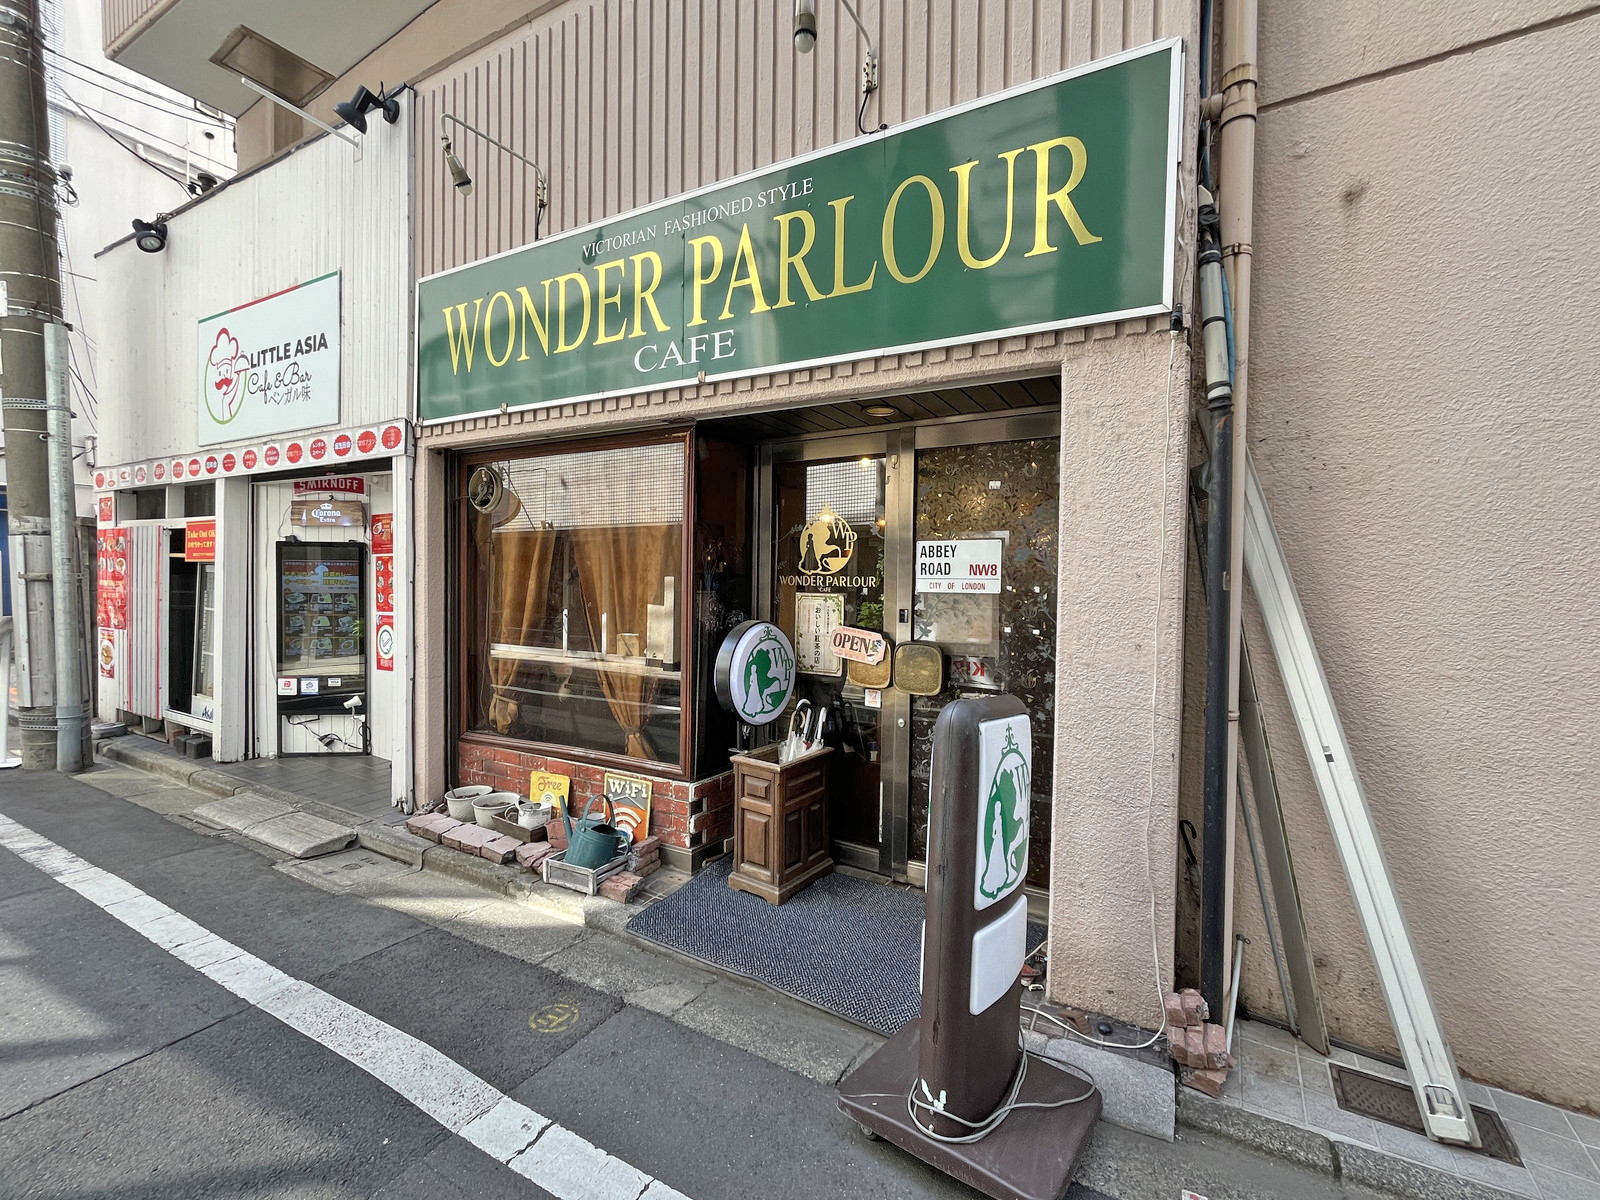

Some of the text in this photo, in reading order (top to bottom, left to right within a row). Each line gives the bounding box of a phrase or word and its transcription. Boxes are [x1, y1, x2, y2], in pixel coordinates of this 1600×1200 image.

[582, 177, 814, 258] VICTORIAN FASHIONED STYLE
[441, 135, 1103, 376] WONDER PARLOUR
[250, 332, 328, 369] LITTLE ASIA
[633, 329, 737, 373] CAFE
[247, 369, 273, 405] Cafe
[268, 383, 312, 406] ベンガル味
[299, 478, 359, 491] SMIRNOFF
[311, 509, 342, 518] Corona
[920, 545, 957, 558] ABBEY
[920, 562, 998, 576] ROAD NW8
[779, 575, 876, 588] WONDER PARLOUR
[929, 582, 986, 591] CITY OF LONDON
[832, 632, 870, 655] OPEN
[537, 776, 562, 792] Free
[607, 779, 648, 798] WiFi
